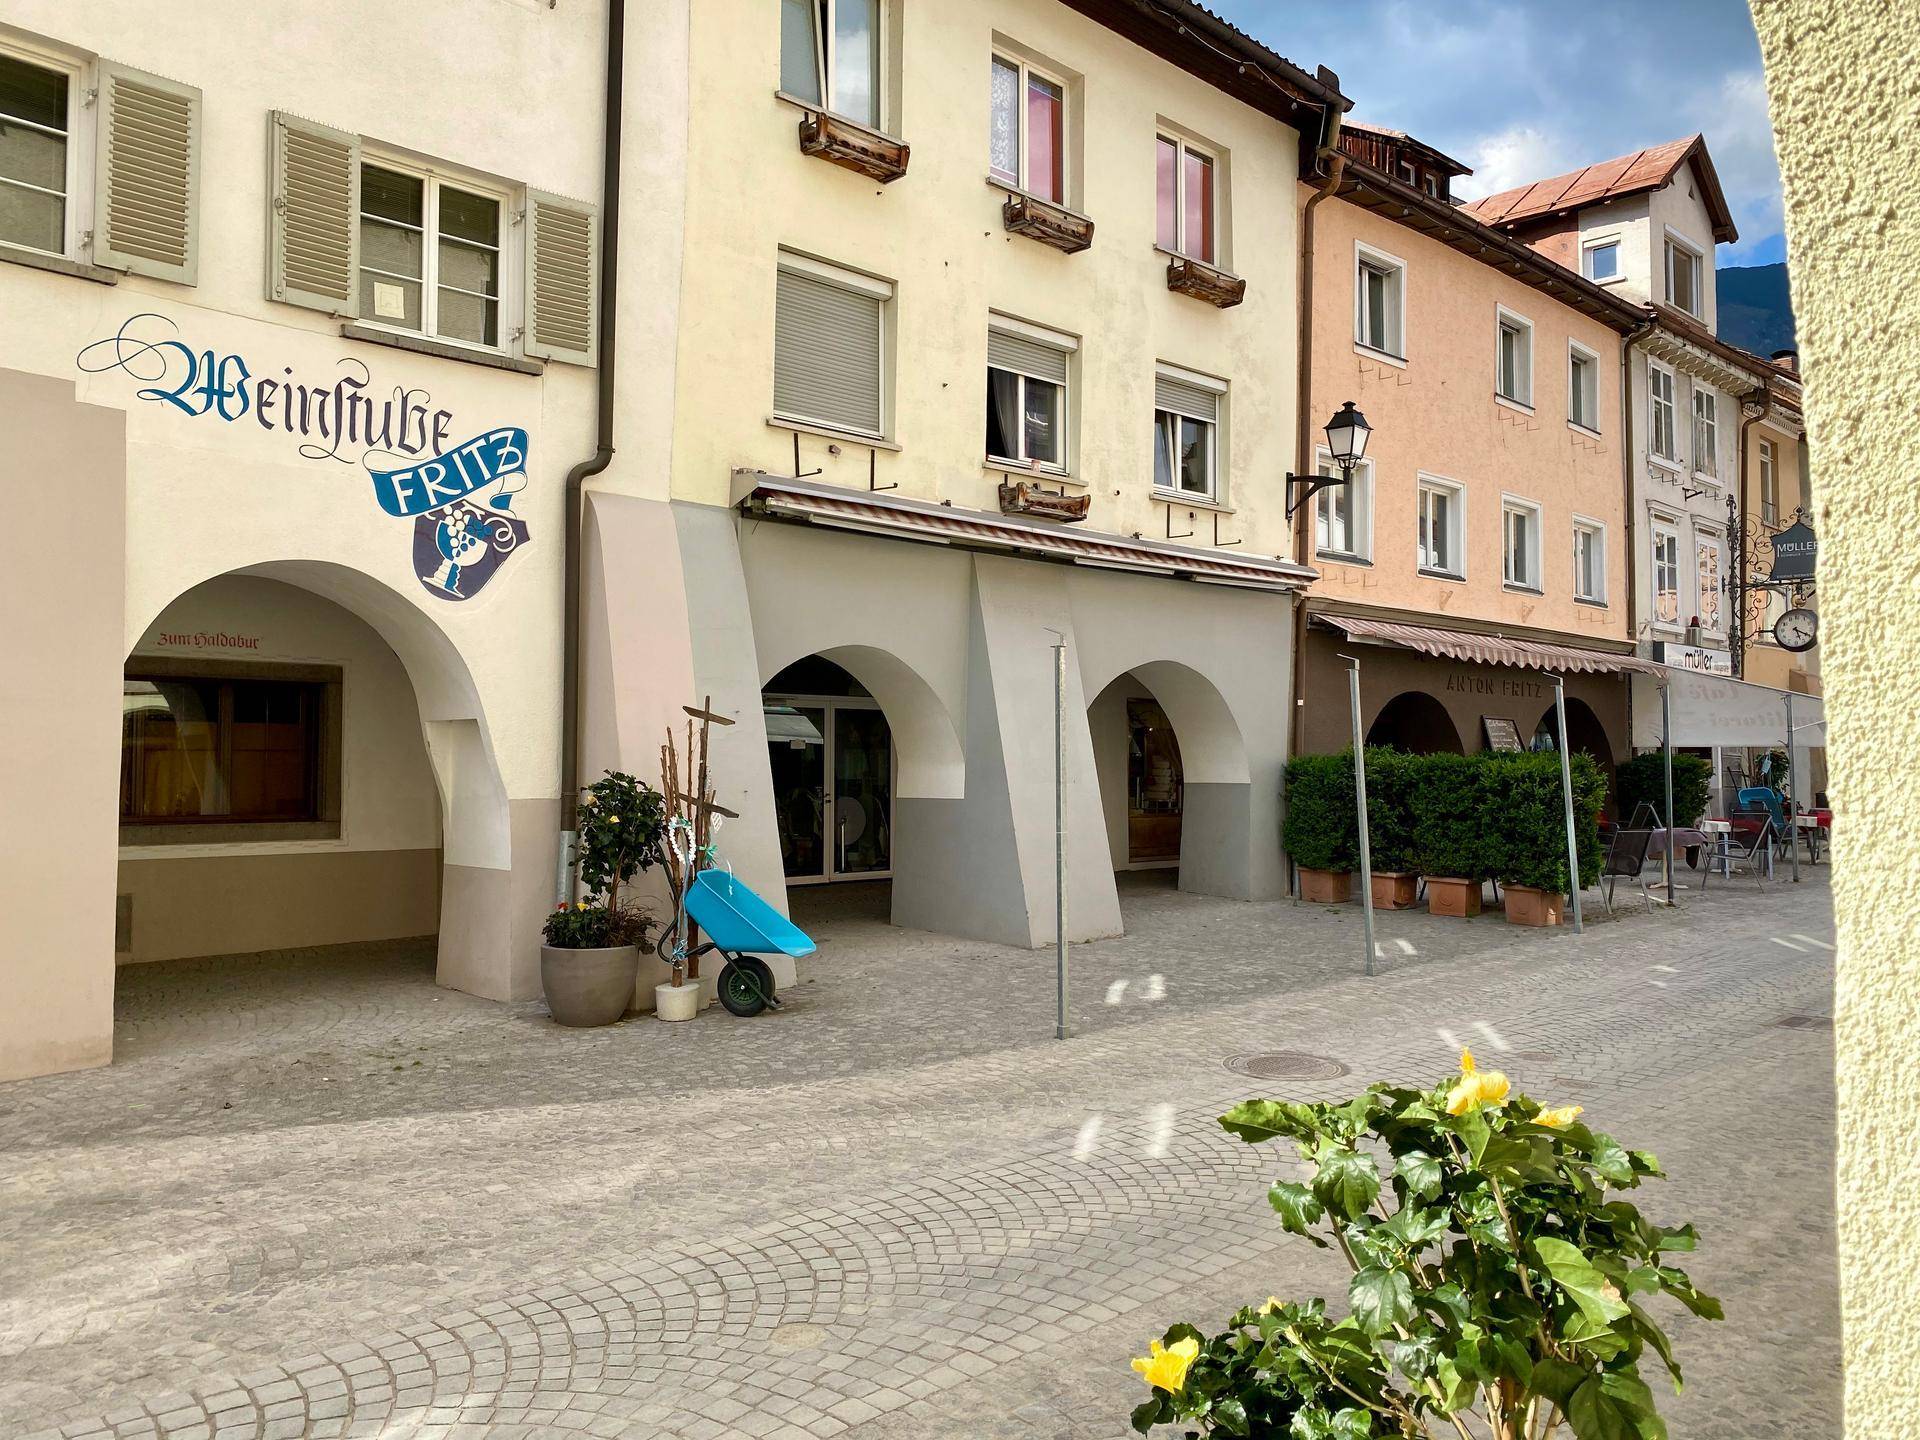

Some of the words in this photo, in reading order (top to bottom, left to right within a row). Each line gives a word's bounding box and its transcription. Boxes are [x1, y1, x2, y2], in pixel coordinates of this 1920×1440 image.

[390, 430, 524, 514] FRITZ
[1684, 649, 1713, 671] müller
[1446, 673, 1493, 695] ANTON
[1502, 679, 1542, 698] FRITZ
